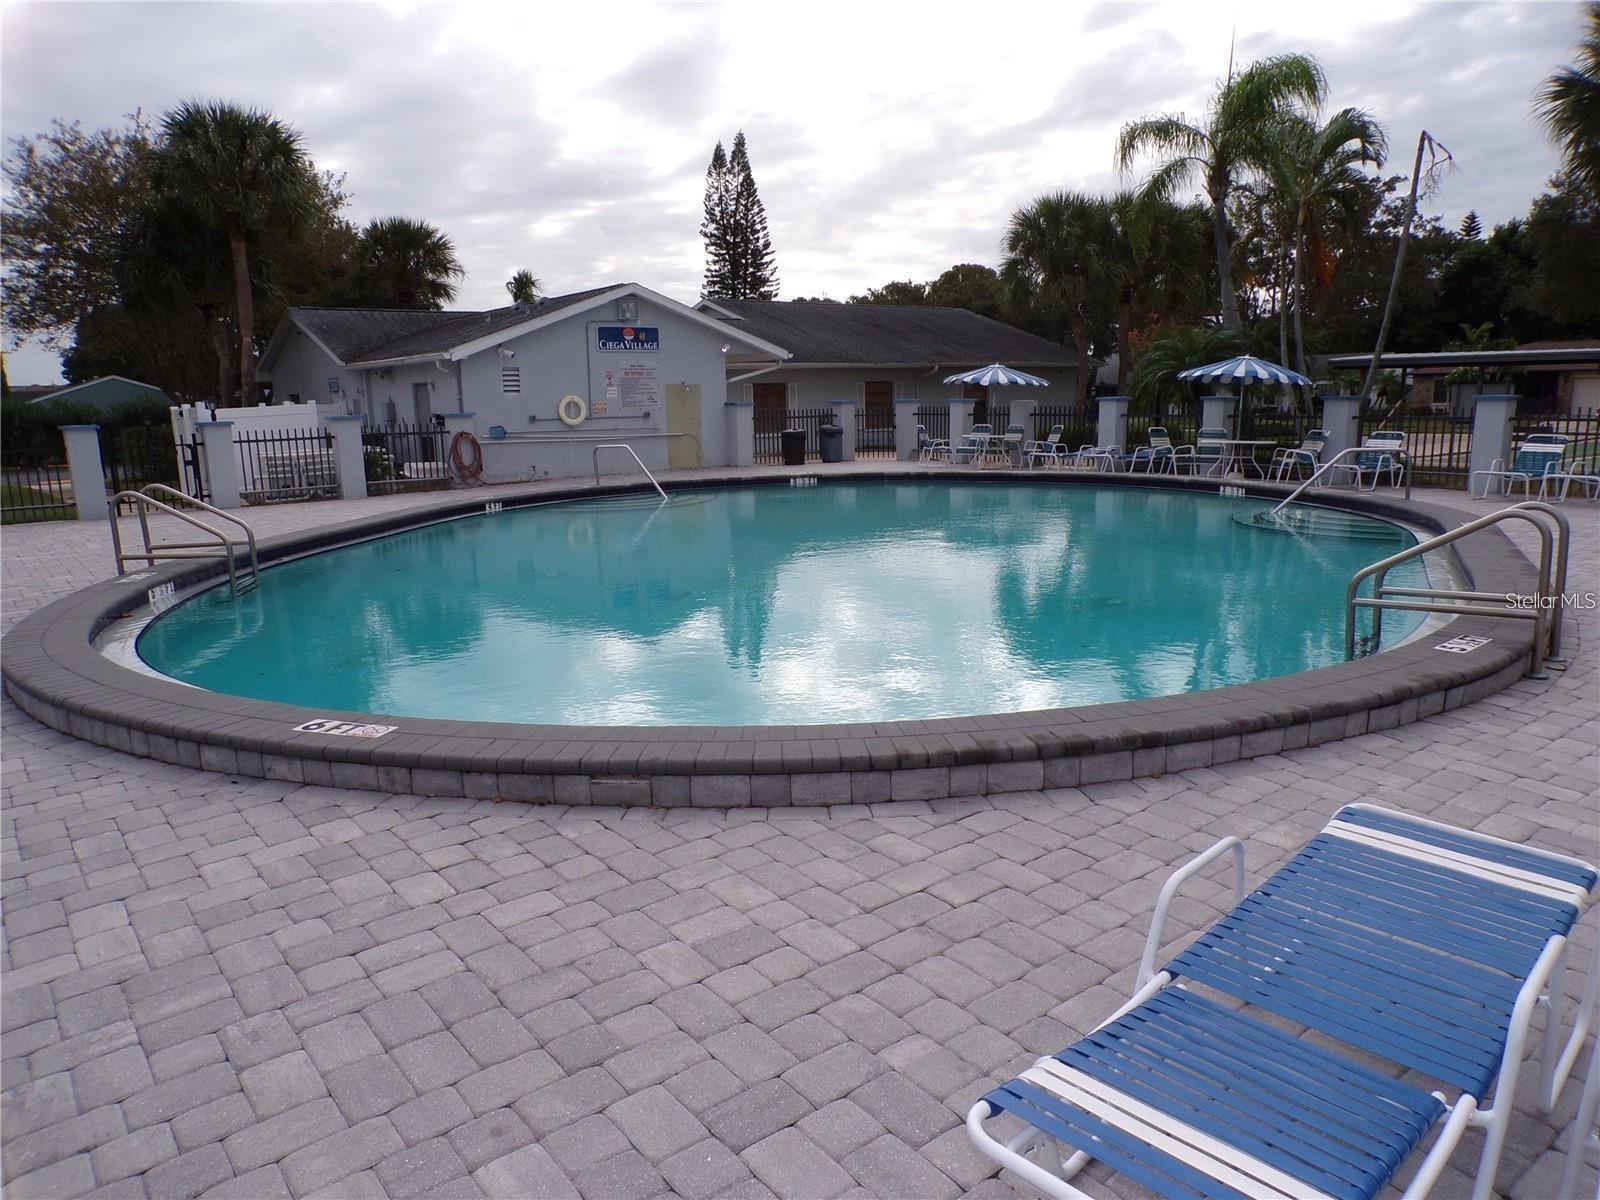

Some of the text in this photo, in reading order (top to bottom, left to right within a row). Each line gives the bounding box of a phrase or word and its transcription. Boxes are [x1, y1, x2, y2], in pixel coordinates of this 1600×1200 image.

[625, 340, 659, 350] VILLAGE
[301, 720, 367, 734] 6 FT
